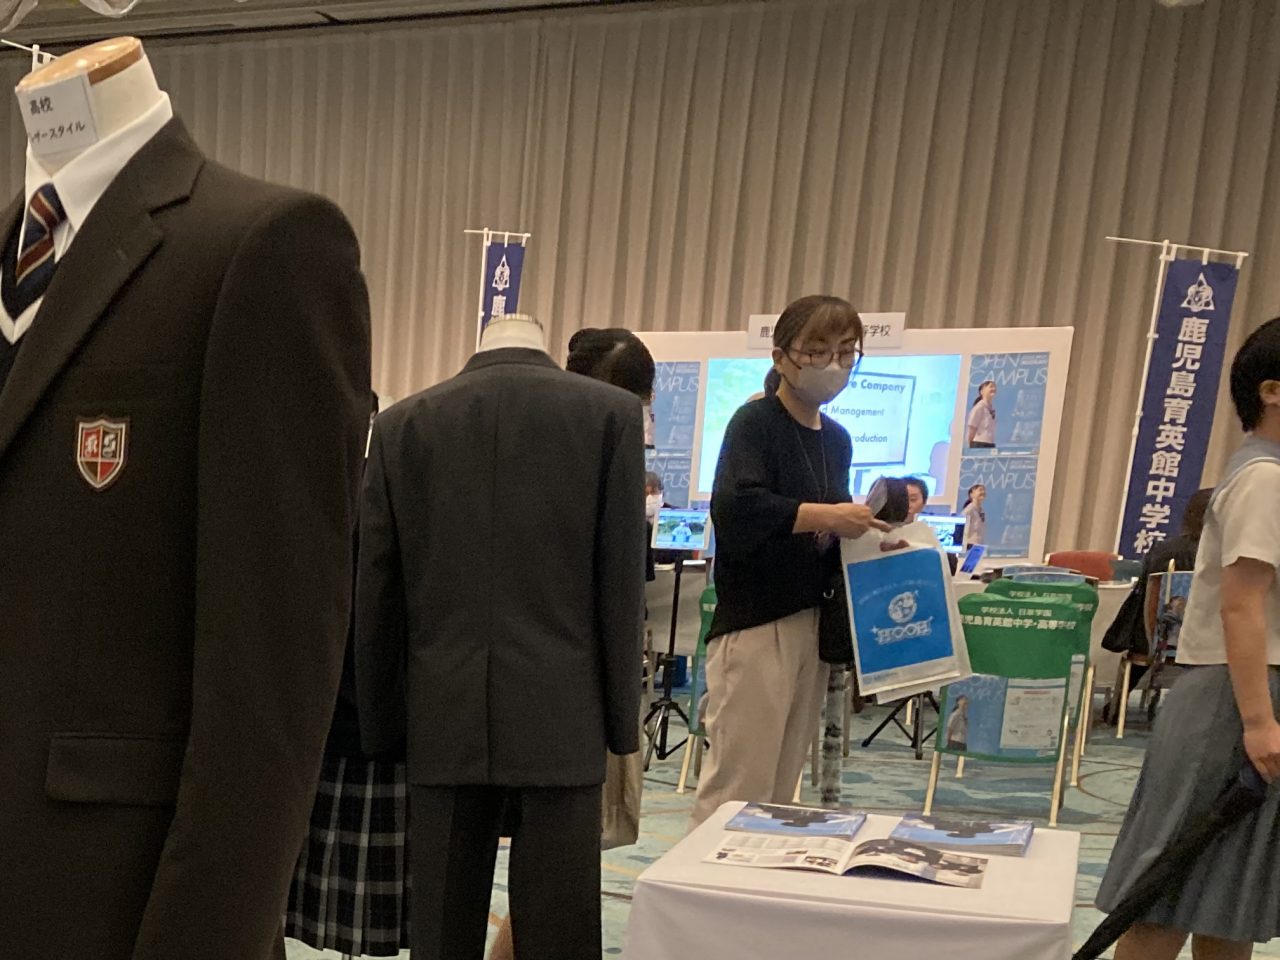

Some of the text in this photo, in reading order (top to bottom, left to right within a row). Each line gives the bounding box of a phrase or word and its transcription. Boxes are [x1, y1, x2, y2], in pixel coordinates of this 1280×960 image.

[860, 378, 906, 394] Company
[830, 405, 885, 417] Management
[852, 433, 888, 443] oduction
